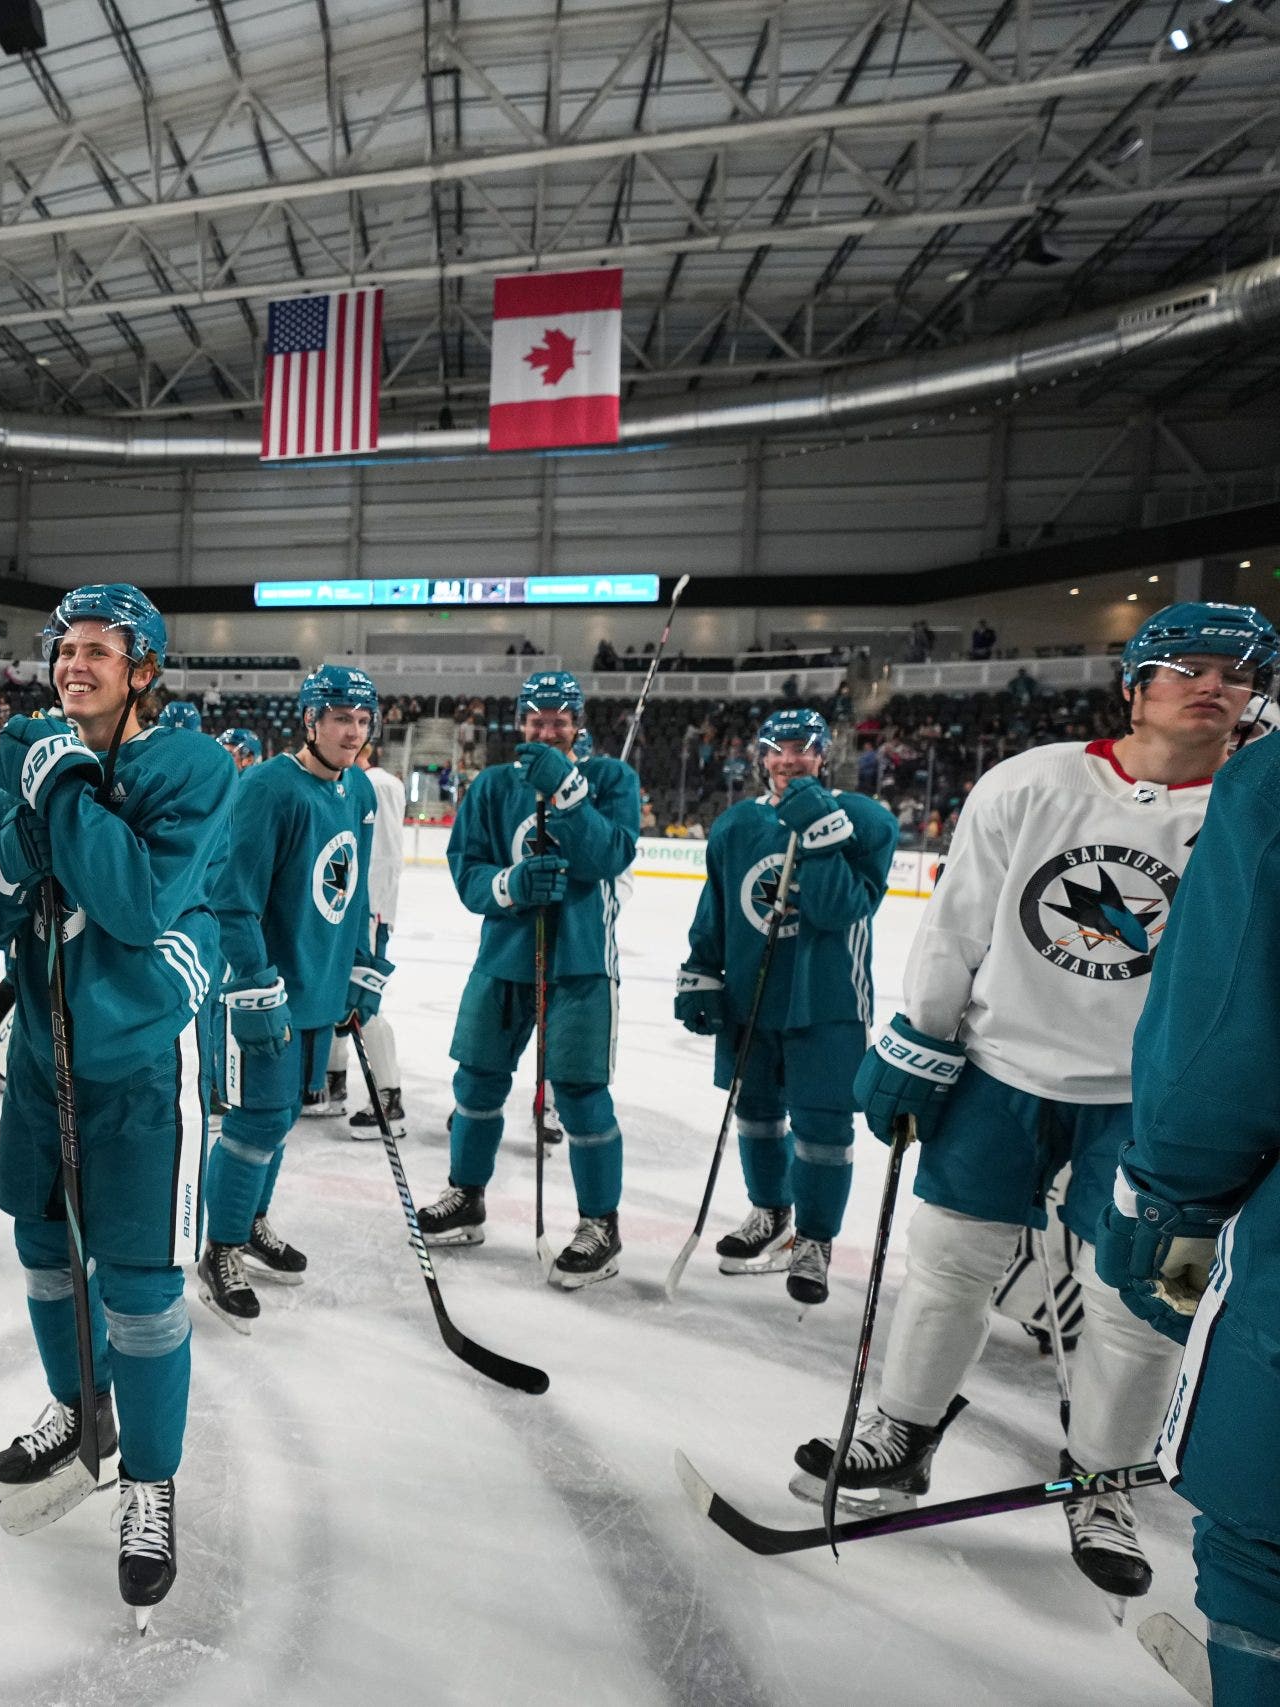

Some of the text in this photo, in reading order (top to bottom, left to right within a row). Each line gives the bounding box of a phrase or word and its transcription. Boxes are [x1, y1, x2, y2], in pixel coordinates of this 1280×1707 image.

[1200, 627, 1254, 638] CCM
[1064, 845, 1175, 885] SAN JOSE
[1041, 944, 1131, 980] SHARKS
[1045, 1462, 1163, 1498] SYNC
